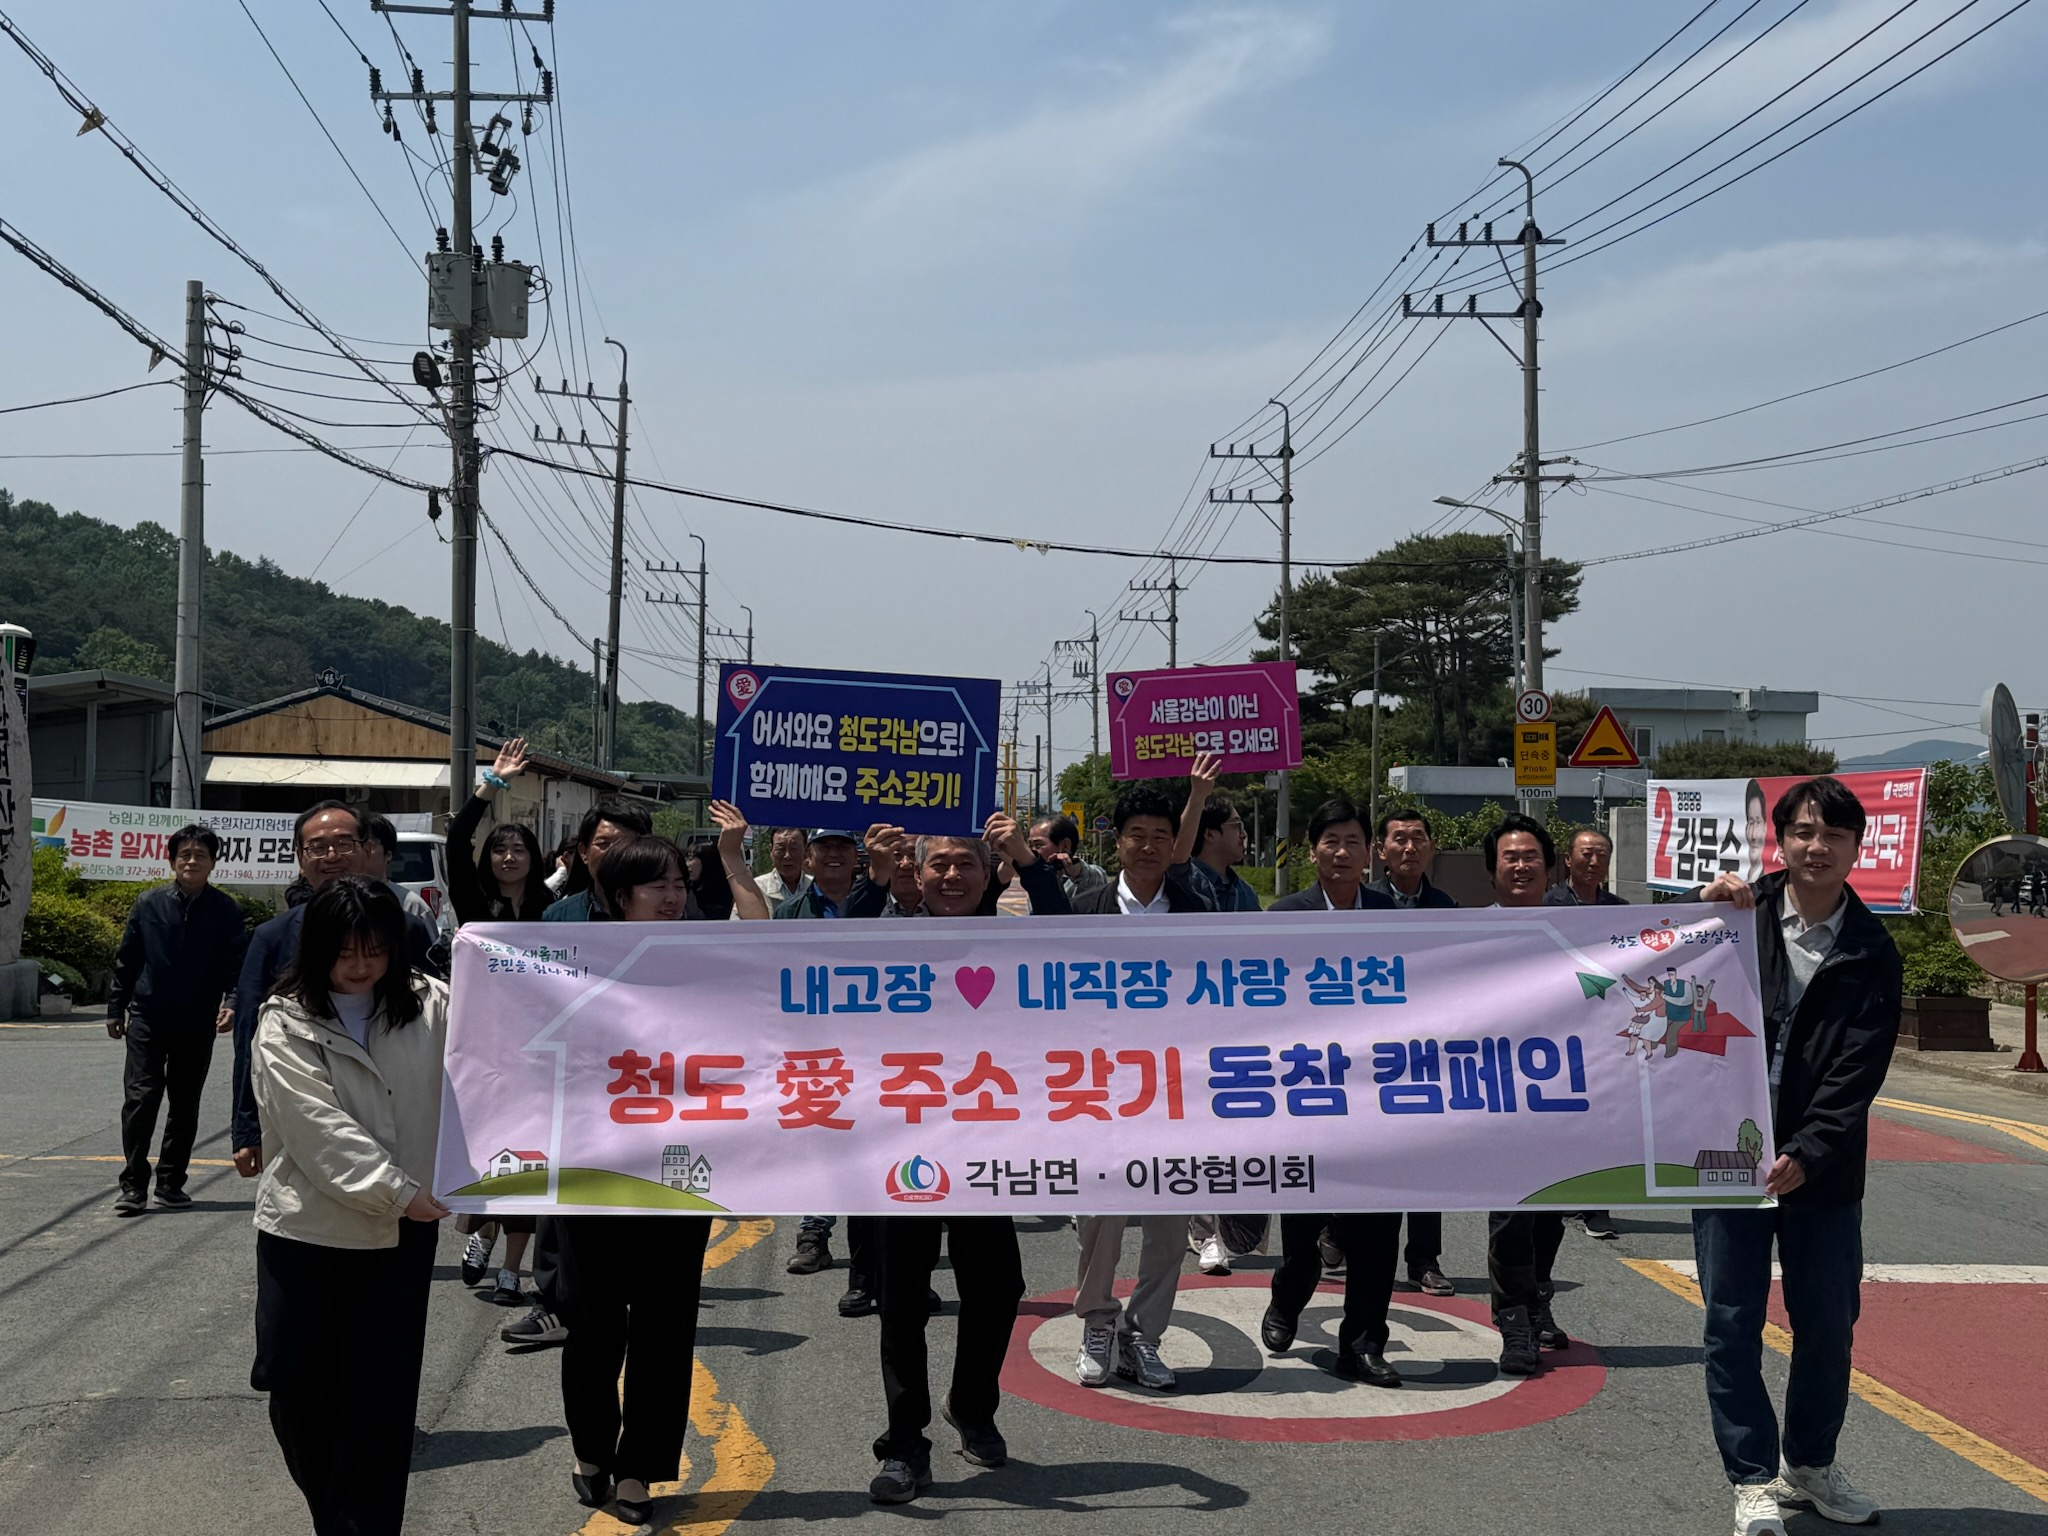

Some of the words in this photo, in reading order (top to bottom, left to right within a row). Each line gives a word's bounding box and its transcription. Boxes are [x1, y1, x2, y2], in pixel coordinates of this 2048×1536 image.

[1149, 694, 1225, 724] 서울강남이
[1228, 692, 1260, 720] 아닌
[1524, 698, 1544, 715] 30
[752, 710, 833, 750] 어서와요
[838, 714, 966, 758] 청도각남으로!
[1134, 730, 1225, 760] 청도각남으로
[1228, 726, 1280, 754] 오세요!
[1520, 750, 1550, 761] 단속중
[750, 760, 847, 802] 함께해요
[854, 767, 962, 809] 주소갖기!
[1520, 788, 1552, 798] 100m
[108, 810, 145, 826] 농협과
[1654, 786, 1673, 880] 2
[70, 828, 114, 858] 농촌
[257, 837, 295, 865] 모집
[1677, 817, 1742, 882] 김문수
[1853, 814, 1907, 870] 민국!
[125, 866, 165, 878] 372-3661
[522, 945, 578, 962] 새롭게!
[1610, 934, 1638, 949] 청도
[1643, 932, 1672, 947] 행복
[488, 958, 527, 973] 군민을
[780, 965, 935, 1015] 내고장
[1017, 960, 1172, 1012] 내직장
[1186, 957, 1290, 1008] 사랑
[1305, 955, 1407, 1006] 실천
[606, 1049, 749, 1125] 청도
[776, 1047, 856, 1130] 愛
[879, 1050, 1021, 1124] 주소
[1044, 1046, 1185, 1122] 갖기
[1207, 1042, 1352, 1119] 동참
[1371, 1035, 1590, 1116] 캠페인
[965, 1158, 1079, 1197] 각남면
[1125, 1154, 1316, 1195] 이장협의회
